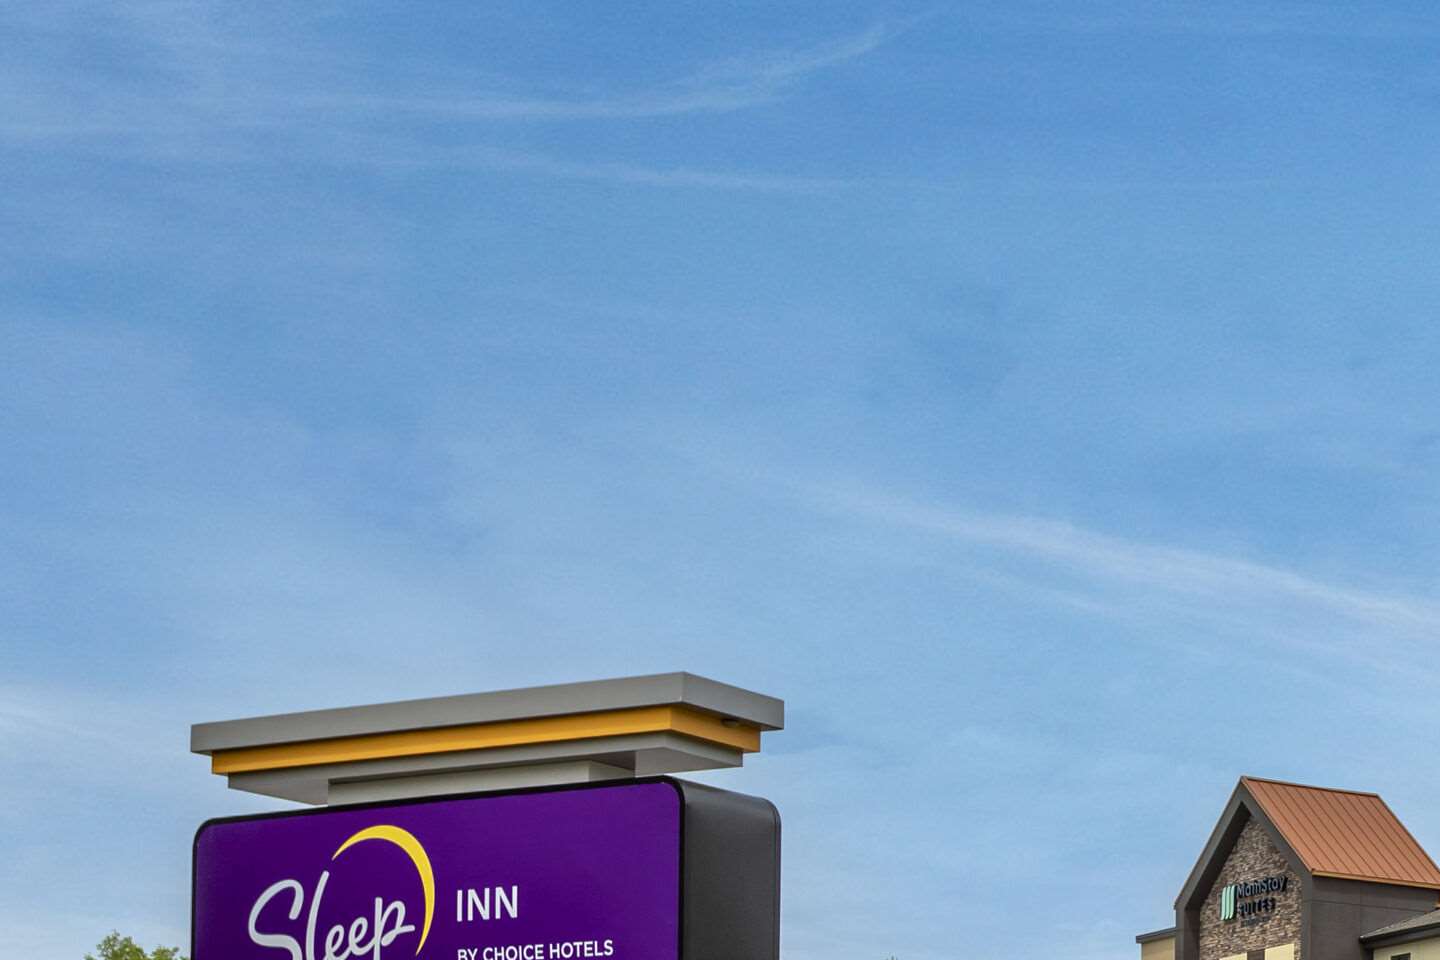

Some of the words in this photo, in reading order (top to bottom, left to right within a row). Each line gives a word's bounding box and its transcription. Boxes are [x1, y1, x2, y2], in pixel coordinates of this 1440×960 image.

[1237, 875, 1286, 898] MainStay
[456, 885, 518, 922] INN
[549, 939, 614, 959] HOTELS
